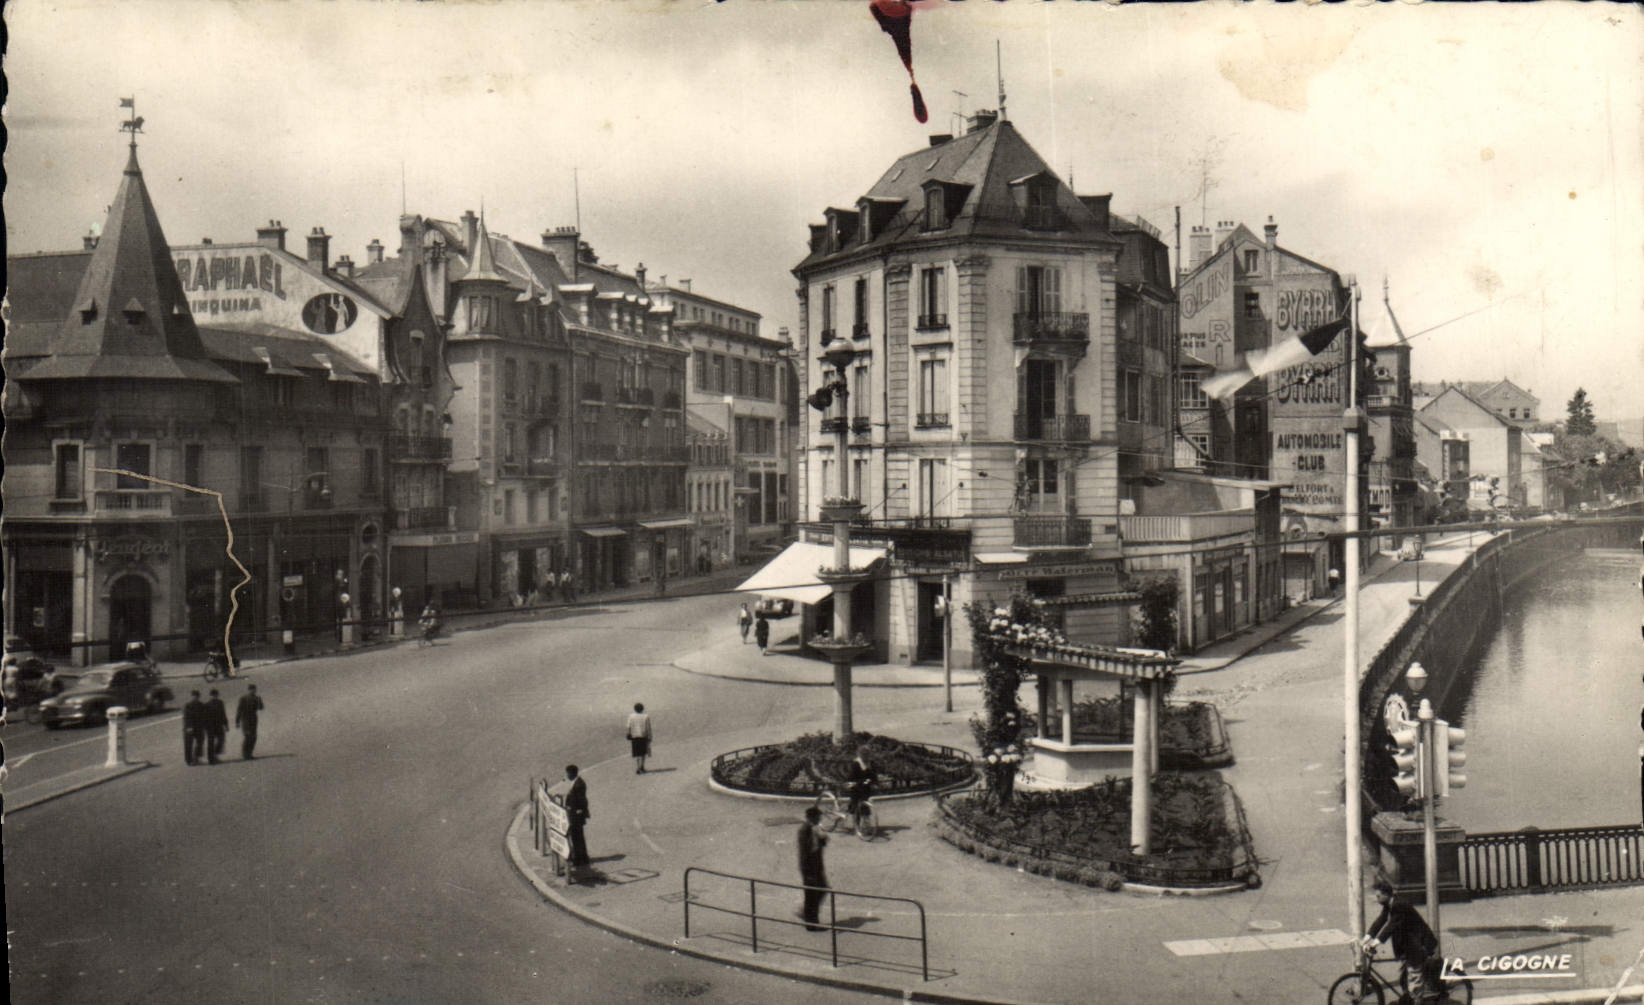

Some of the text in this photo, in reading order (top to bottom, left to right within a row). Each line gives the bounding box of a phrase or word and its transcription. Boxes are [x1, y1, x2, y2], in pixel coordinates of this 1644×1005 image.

[176, 254, 287, 301] RAPHAEL
[1277, 289, 1336, 332] BYRRH
[1277, 362, 1341, 404] BYRRH
[1277, 434, 1342, 449] AUTOMOBILE
